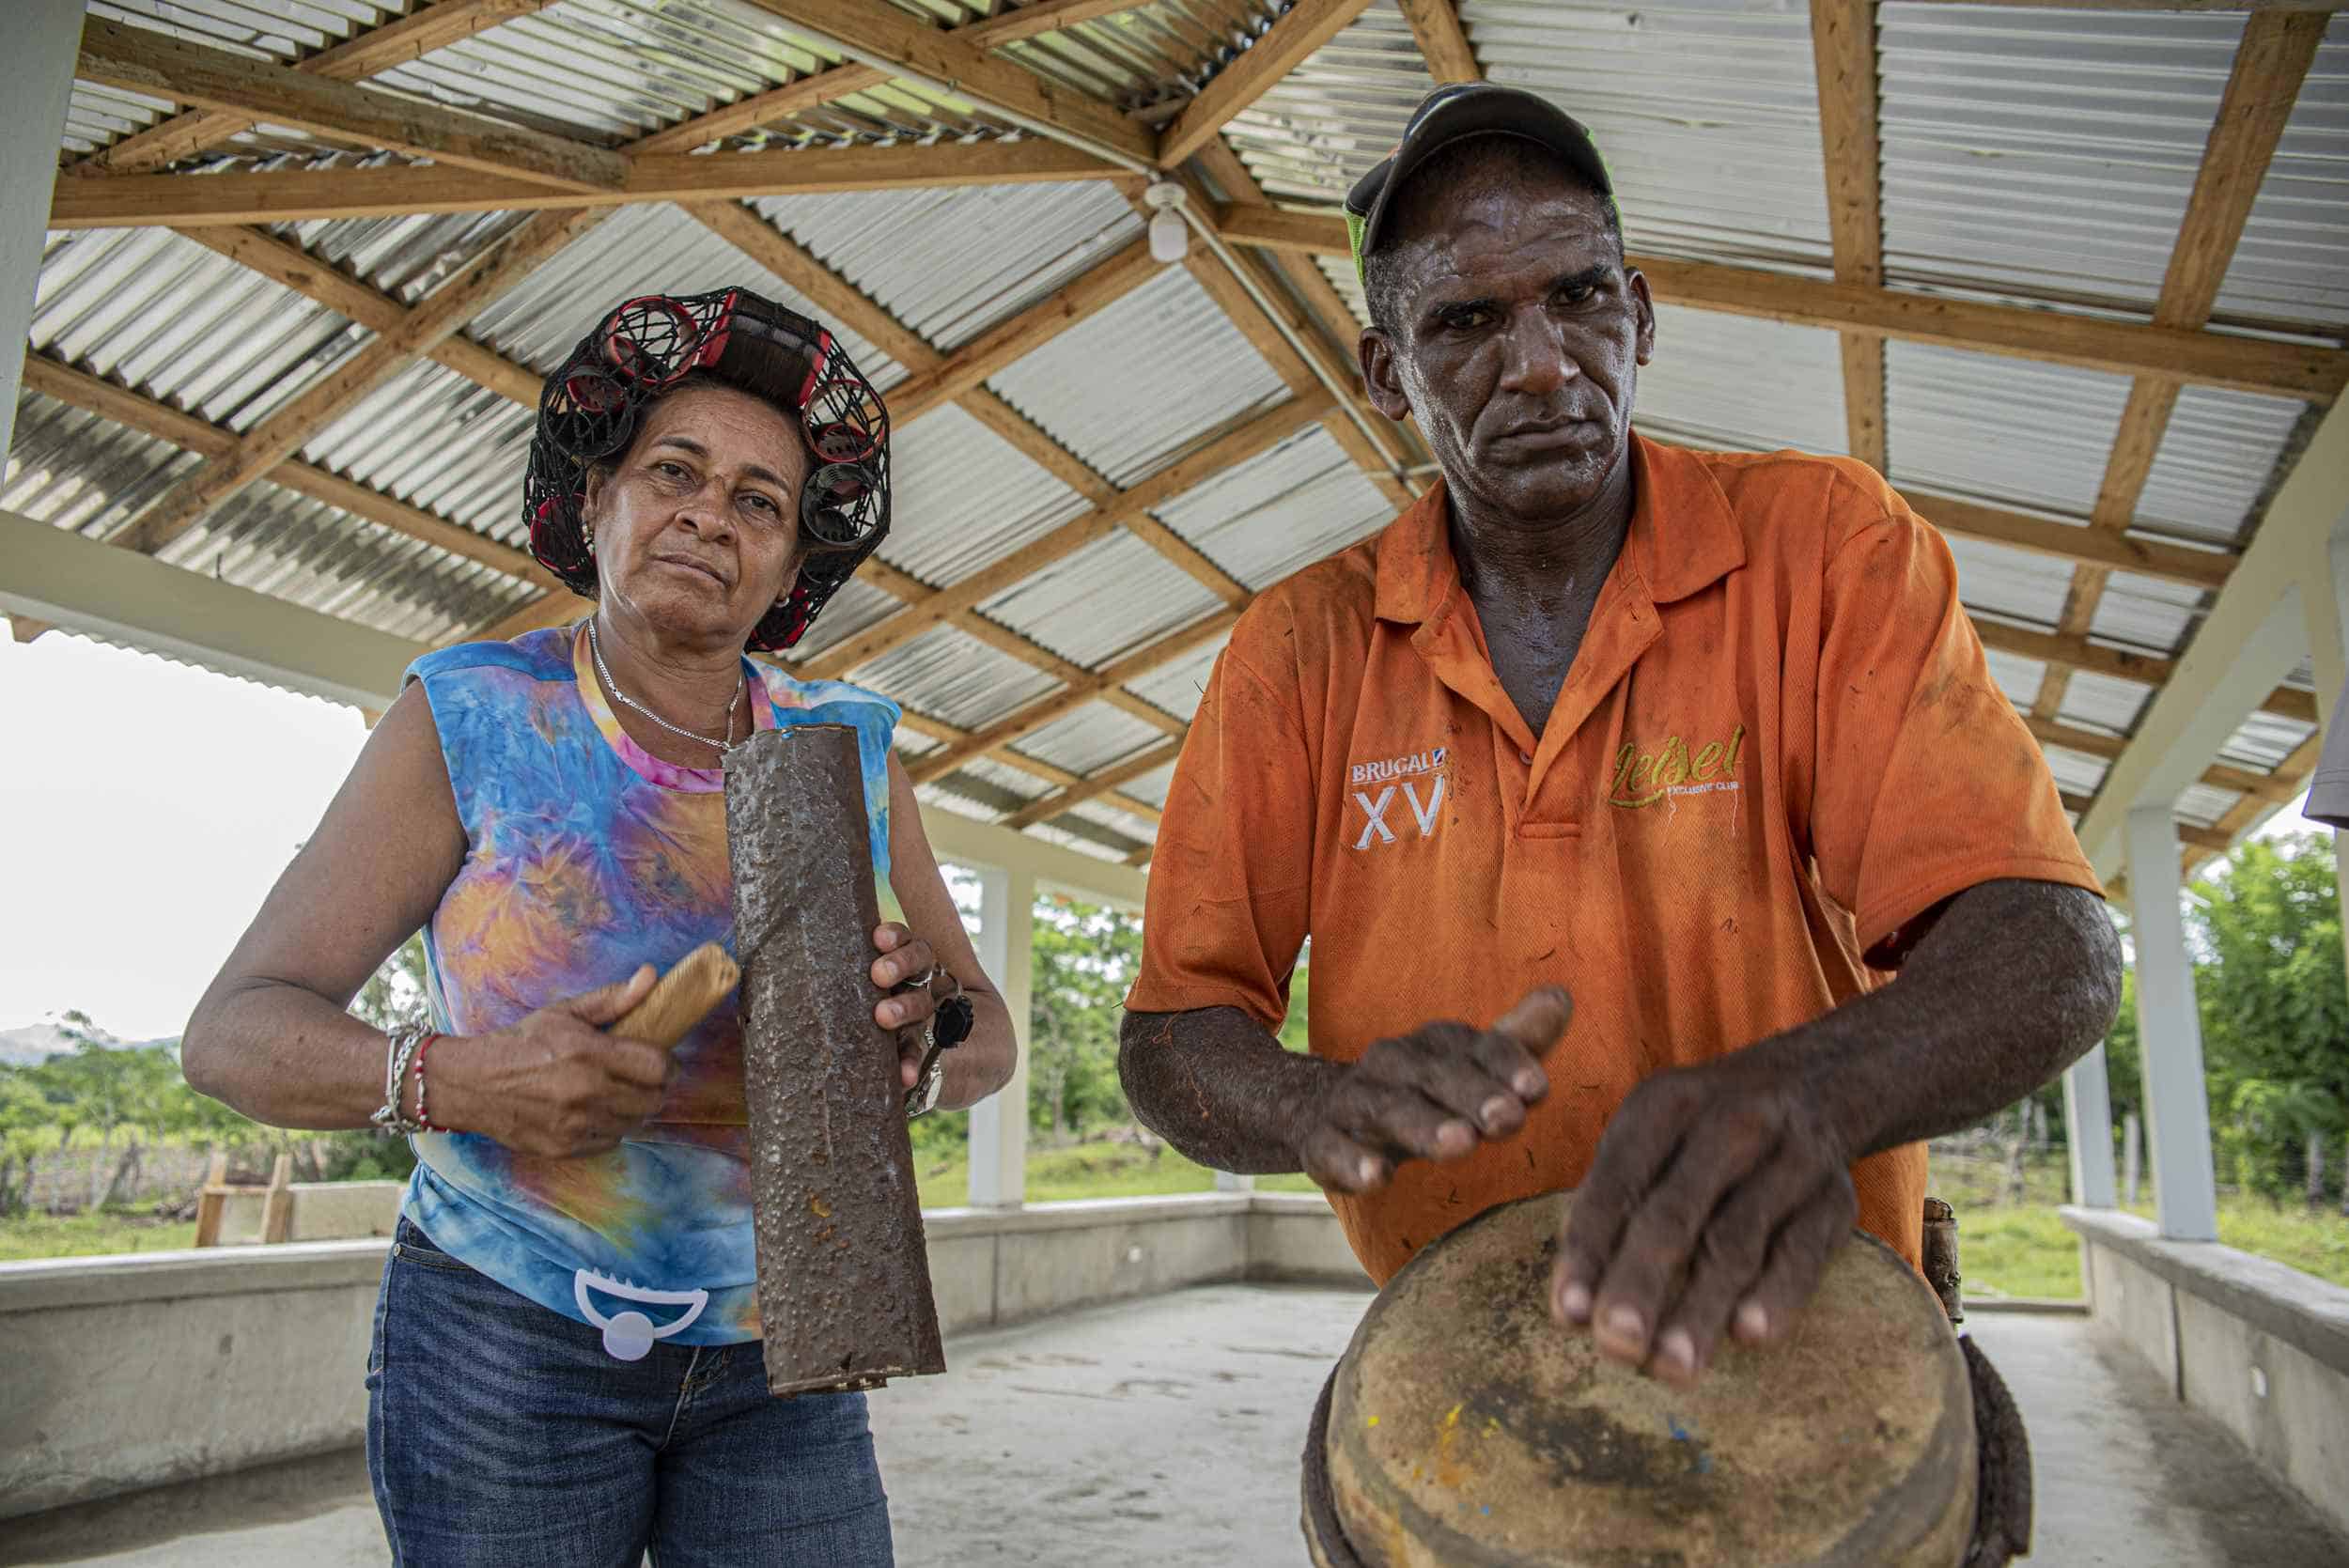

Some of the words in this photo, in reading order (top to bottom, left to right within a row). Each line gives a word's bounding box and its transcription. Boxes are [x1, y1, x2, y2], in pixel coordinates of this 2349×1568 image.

[1352, 751, 1431, 783] BRUGAL
[1716, 781, 1739, 790] CLUB
[1352, 774, 1445, 850] XV
